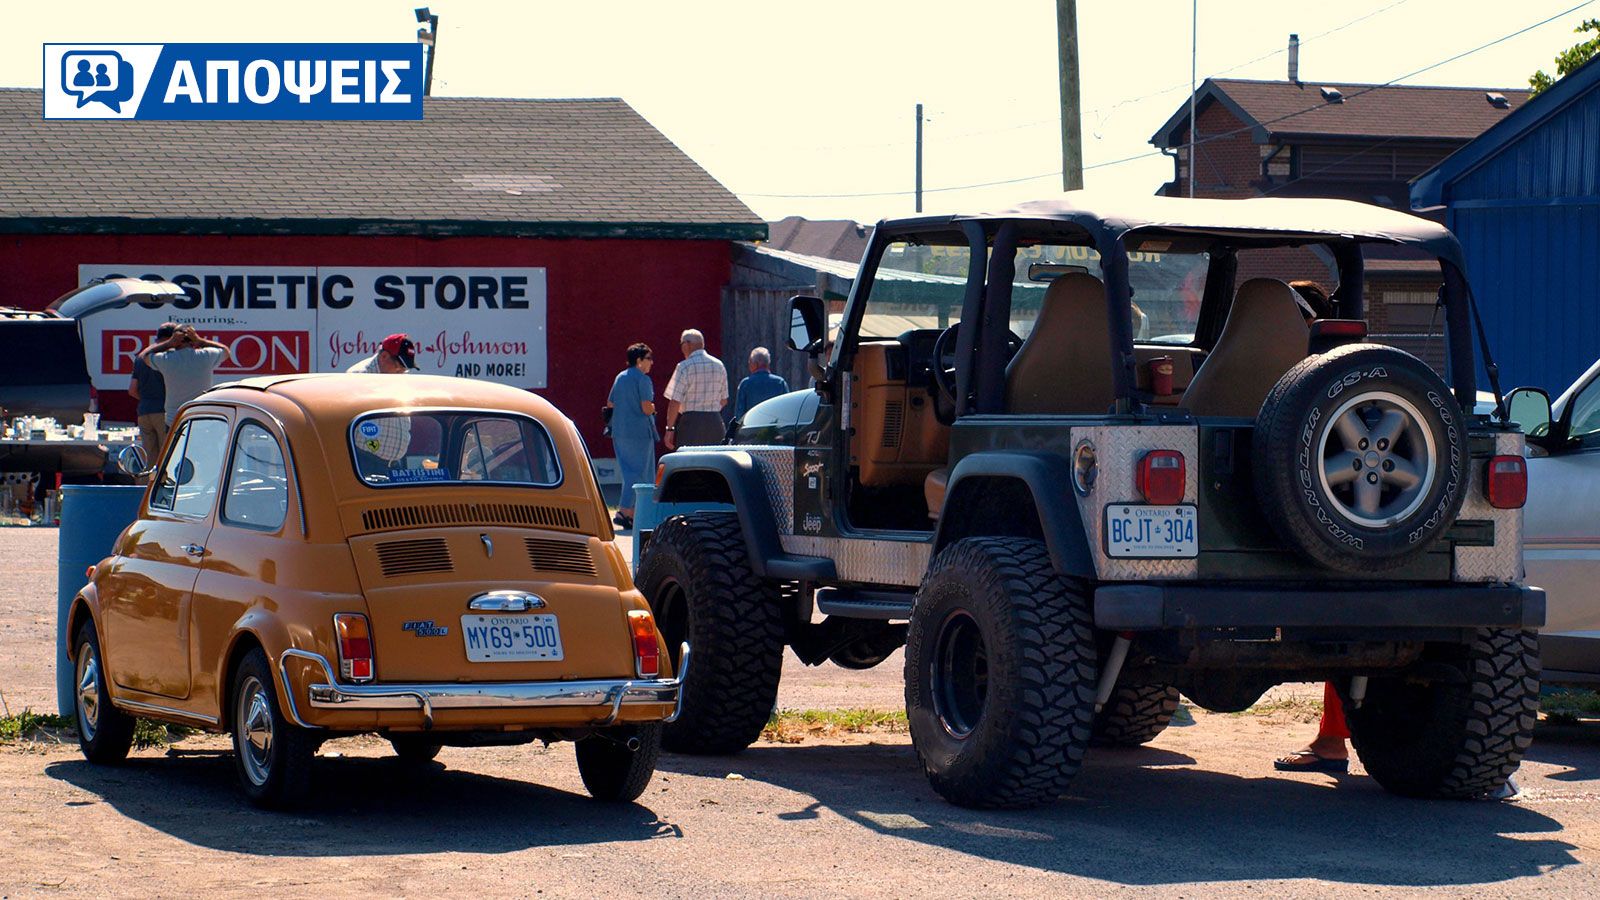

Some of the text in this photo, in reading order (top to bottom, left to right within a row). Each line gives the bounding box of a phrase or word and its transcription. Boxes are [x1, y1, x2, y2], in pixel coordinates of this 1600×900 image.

[104, 273, 530, 310] SMETIC STORE
[436, 330, 528, 368] Johnson
[455, 362, 526, 378] AND MORE!
[806, 430, 821, 444] TJ
[391, 468, 445, 477] BATTISTINI
[1298, 407, 1364, 550] WRANGLER
[1408, 391, 1463, 545] GOODYEAR
[802, 512, 822, 534] Jeep
[1134, 509, 1171, 517] ONTARIO
[1112, 518, 1194, 543] BCJT 304
[491, 617, 529, 625] ONTARIO
[467, 625, 557, 649] MY69 500
